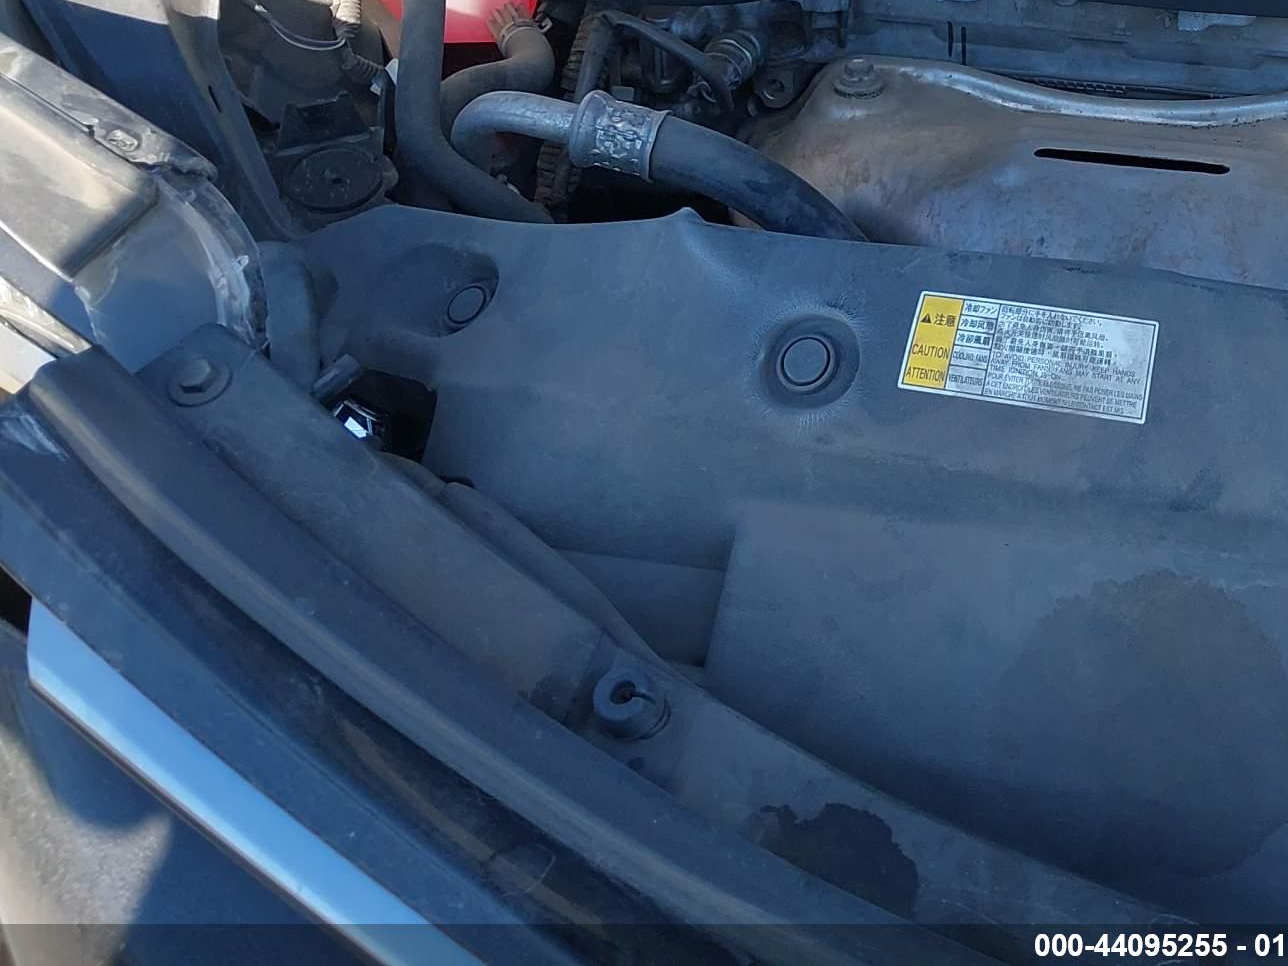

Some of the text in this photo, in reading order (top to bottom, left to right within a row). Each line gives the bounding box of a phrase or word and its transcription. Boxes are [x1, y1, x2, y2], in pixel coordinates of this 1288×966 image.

[934, 313, 956, 325] 注意
[912, 344, 949, 358] CAUTION
[952, 350, 974, 361] COOLING
[906, 366, 945, 380] ATTENTION
[1011, 361, 1030, 369] FROM
[1075, 369, 1089, 377] MAY
[1091, 372, 1112, 380] START
[1091, 365, 1109, 373] KEEP
[1112, 367, 1136, 377] HANDS
[984, 387, 993, 395] EN
